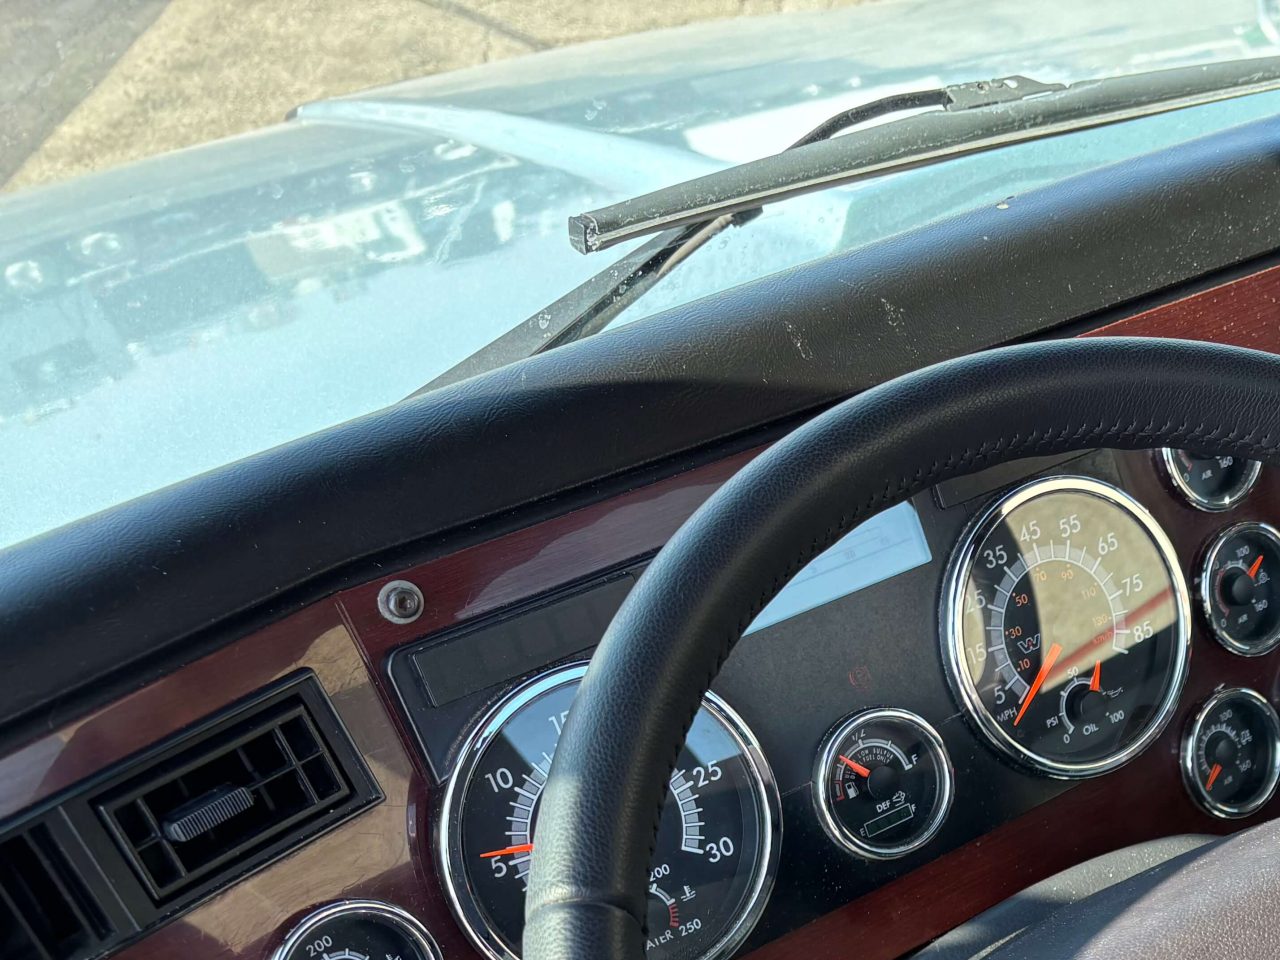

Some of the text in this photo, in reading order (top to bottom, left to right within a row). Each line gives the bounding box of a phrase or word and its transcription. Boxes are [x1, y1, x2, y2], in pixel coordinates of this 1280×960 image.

[1219, 456, 1233, 469] 160
[1020, 520, 1041, 543] 45
[1059, 514, 1081, 537] 55
[1098, 533, 1118, 555] 65
[984, 545, 1008, 569] 35
[1035, 570, 1047, 581] 70
[1061, 569, 1073, 581] 90
[1121, 573, 1143, 597] 75
[966, 590, 986, 613] 25
[1015, 593, 1028, 607] 50
[1010, 626, 1022, 639] 30
[1133, 620, 1153, 643] 85
[967, 643, 987, 664] 15
[1019, 658, 1030, 669] 10
[1067, 666, 1079, 678] 50
[995, 686, 1006, 704] 5
[997, 707, 1018, 723] MPH
[1046, 716, 1059, 728] PSI
[1108, 710, 1125, 724] 100
[1083, 722, 1099, 736] OIL
[1063, 734, 1070, 743] 0
[911, 754, 918, 765] F
[485, 768, 514, 792] 10
[692, 760, 722, 788] 25
[876, 800, 891, 813] DEF
[705, 837, 734, 863] 30
[491, 857, 507, 878] 5
[679, 918, 702, 936] 250
[306, 935, 333, 957] 200
[646, 930, 674, 951] ATER
